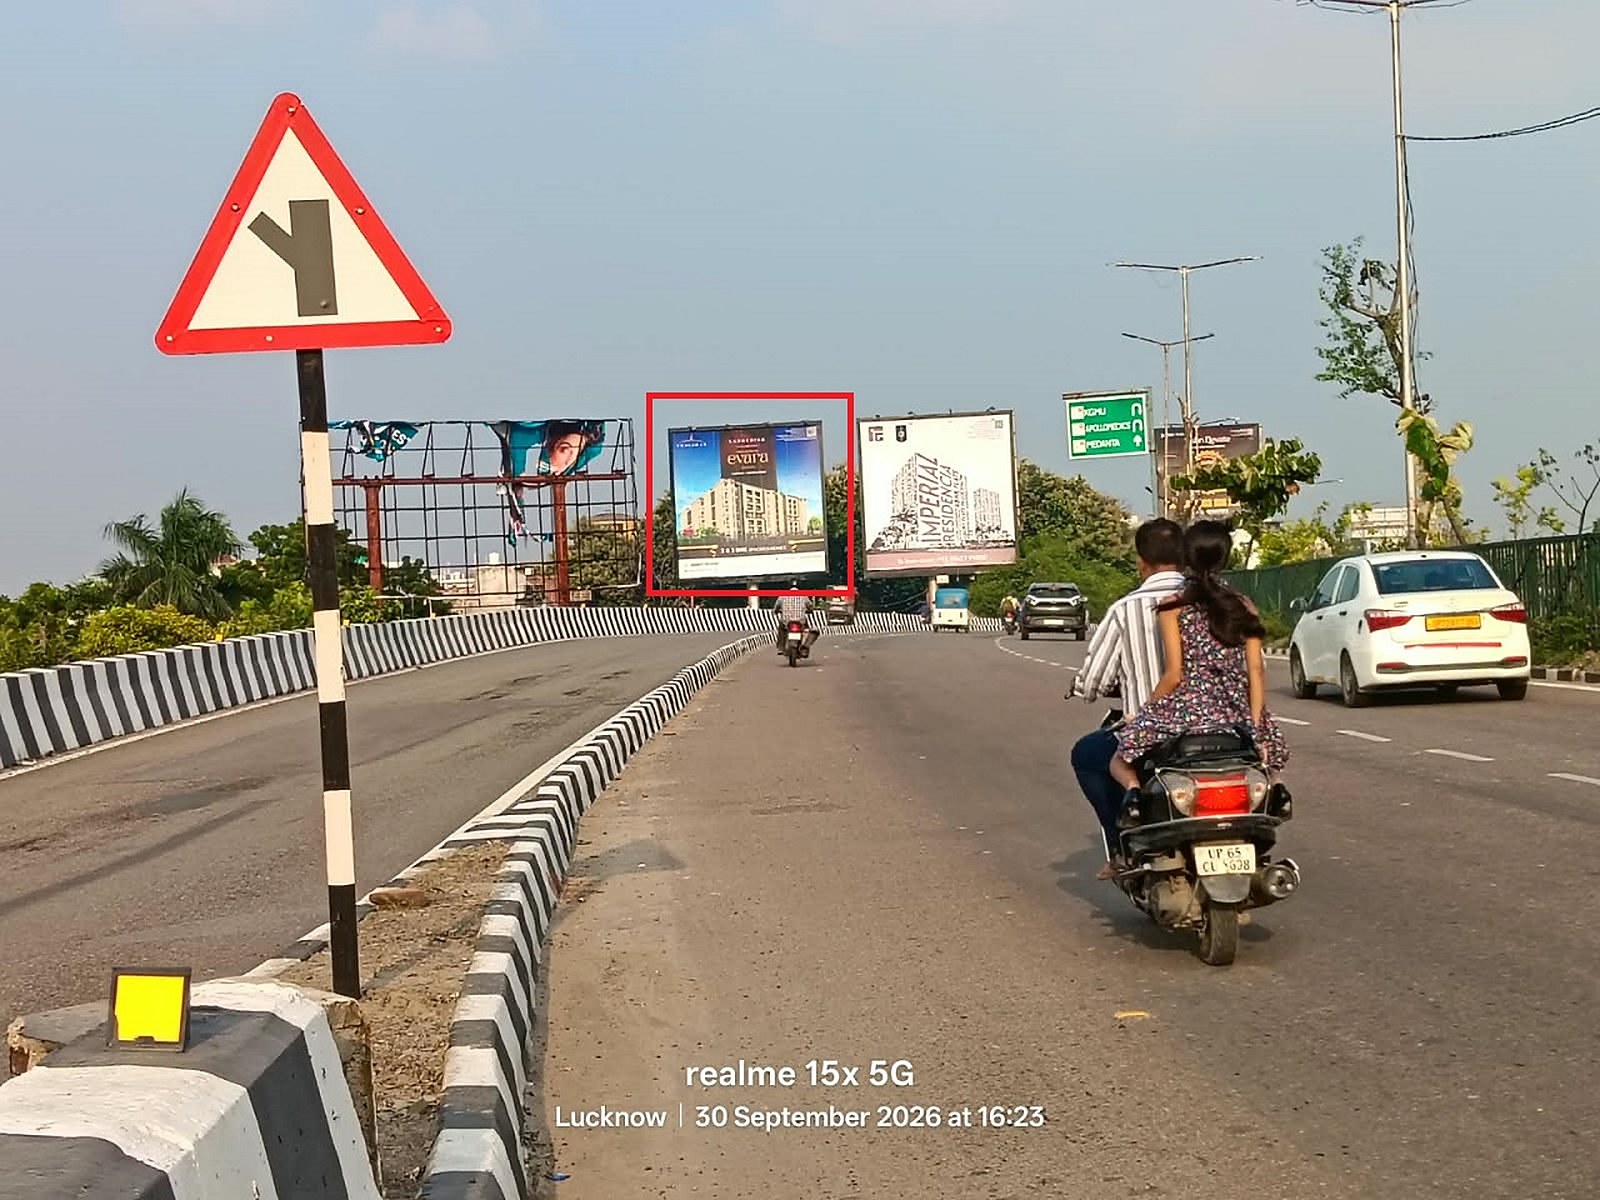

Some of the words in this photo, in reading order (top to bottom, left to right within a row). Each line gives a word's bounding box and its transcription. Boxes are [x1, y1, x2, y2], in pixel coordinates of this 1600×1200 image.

[915, 452, 942, 543] IMPERIAL
[1208, 848, 1223, 859] UP
[1227, 847, 1241, 859] 65
